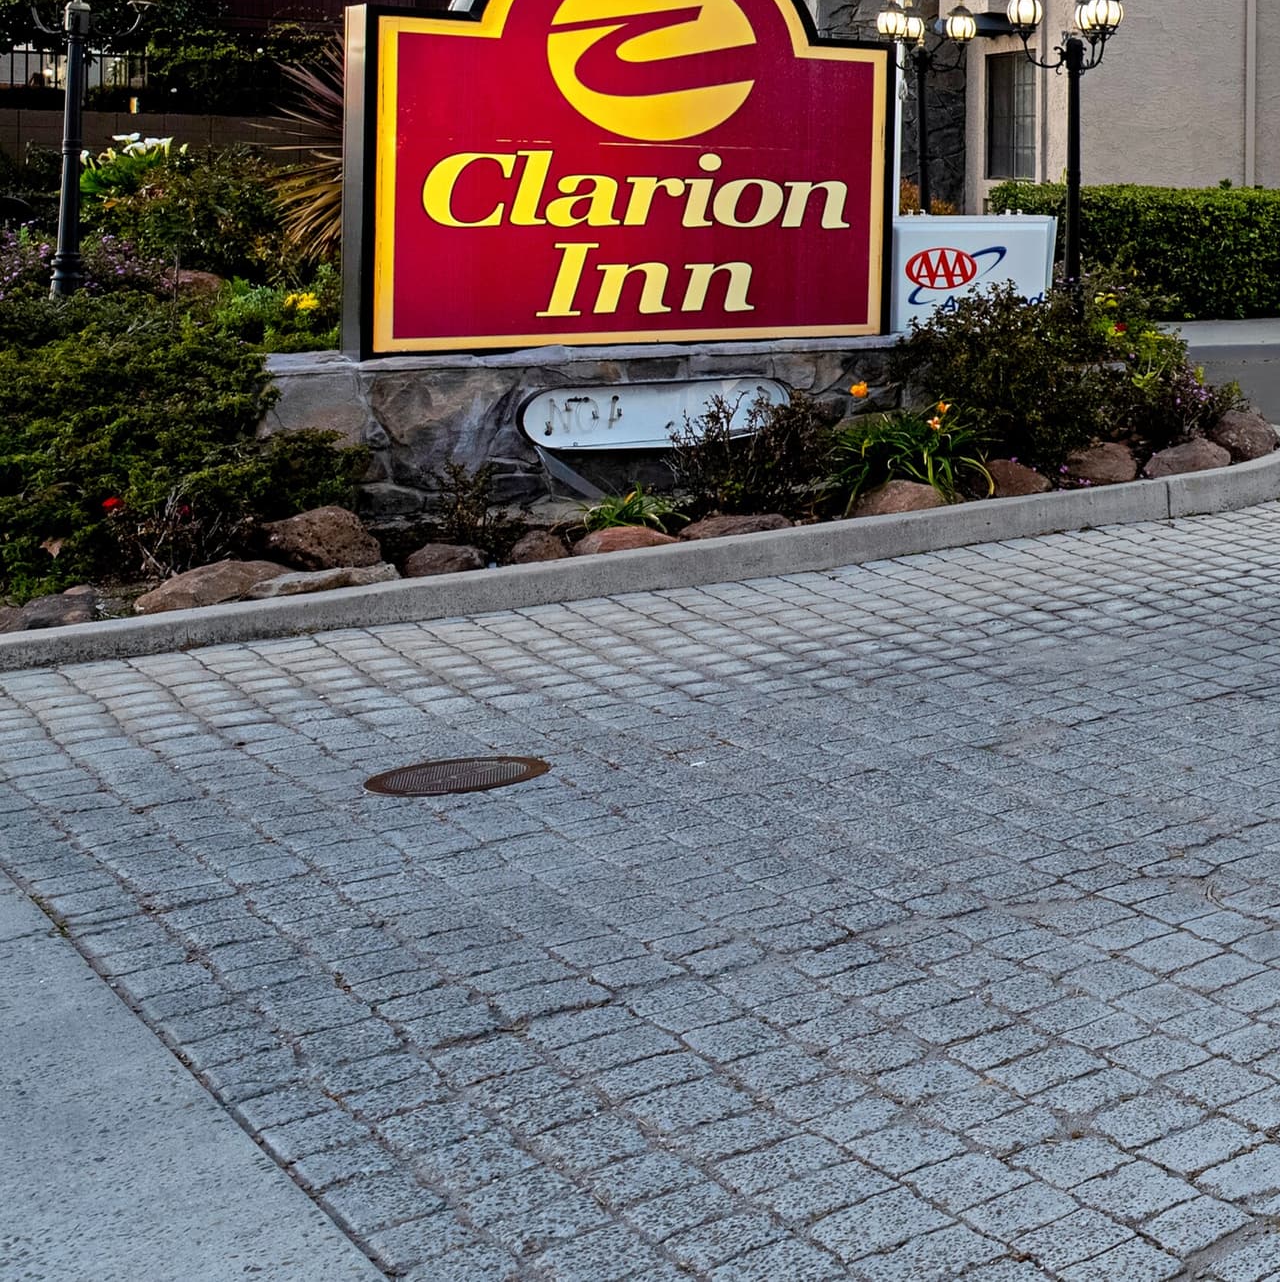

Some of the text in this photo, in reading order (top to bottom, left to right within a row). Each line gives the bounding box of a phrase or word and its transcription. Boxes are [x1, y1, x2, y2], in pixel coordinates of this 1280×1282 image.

[422, 150, 850, 229] Clarion
[535, 242, 755, 317] Inn
[912, 248, 973, 288] AAA
